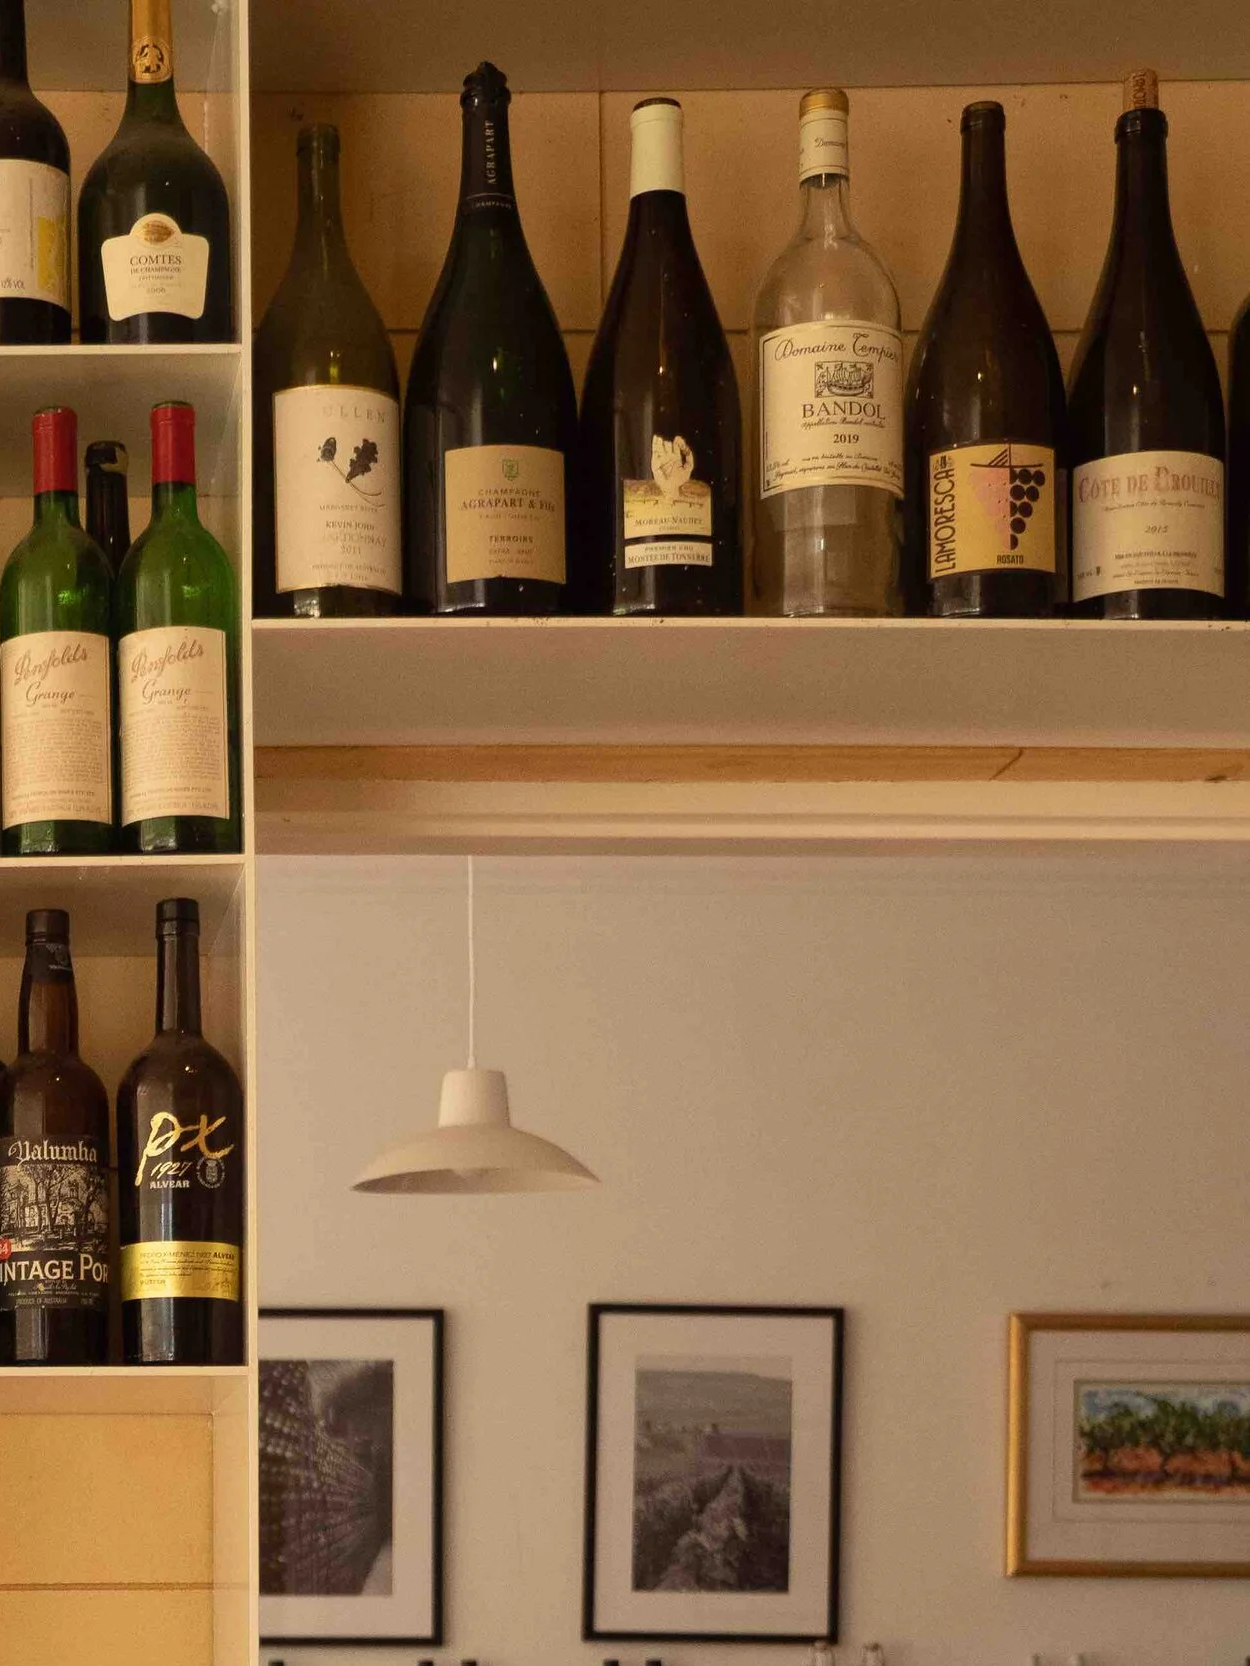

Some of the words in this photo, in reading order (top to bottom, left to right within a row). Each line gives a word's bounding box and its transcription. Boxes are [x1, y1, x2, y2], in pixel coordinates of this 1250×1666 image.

[130, 254, 182, 266] COMTES
[774, 338, 847, 361] Domaine
[852, 332, 899, 363] Tempier
[802, 400, 886, 420] BANDOL
[833, 433, 859, 443] 2019
[461, 498, 523, 511] AGRAPART
[325, 521, 351, 530] KEVIN
[935, 459, 955, 574] LAMORESCA
[489, 535, 533, 544] TERROIRS
[997, 554, 1024, 565] ROSATO
[13, 643, 88, 687] Penfolds
[131, 639, 205, 684] Penfolds
[26, 681, 76, 707] Grange
[142, 679, 192, 705] Grange
[8, 1140, 98, 1168] Yalumba
[150, 1161, 193, 1179] 1927
[150, 1181, 190, 1189] ALVEAR
